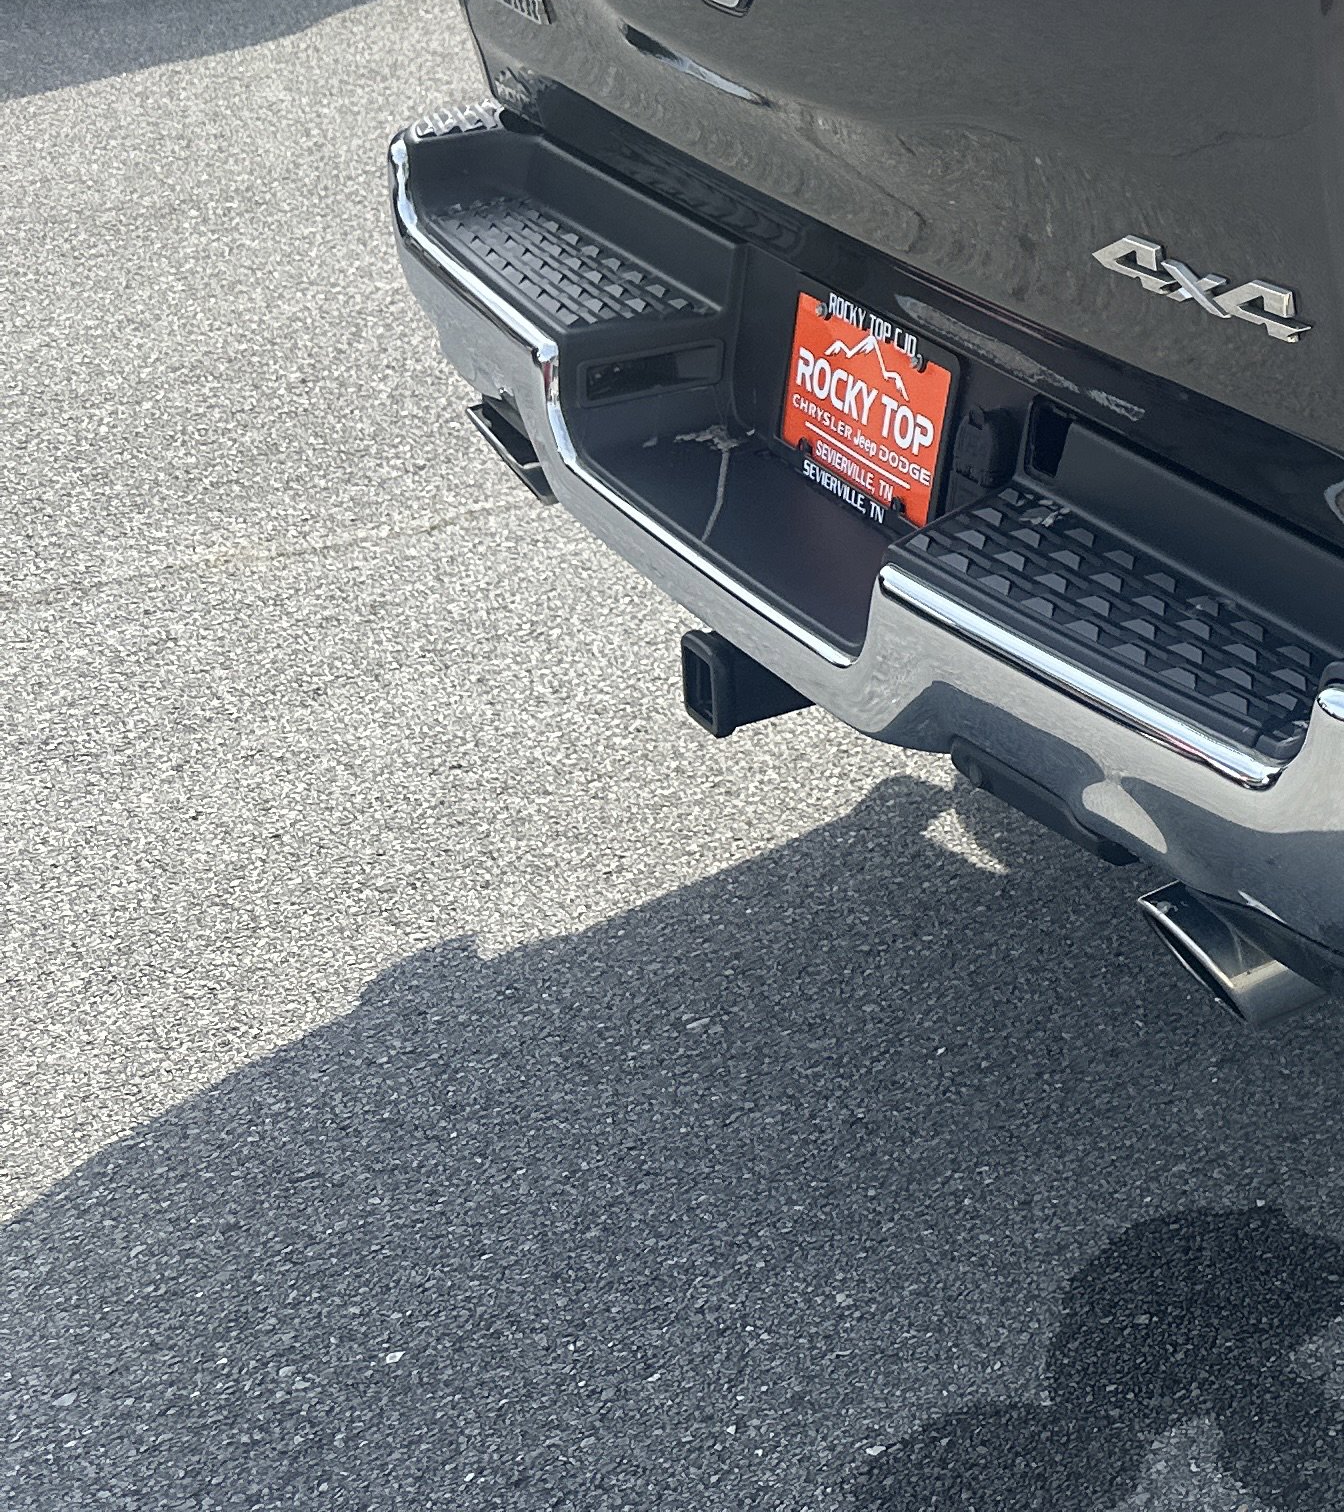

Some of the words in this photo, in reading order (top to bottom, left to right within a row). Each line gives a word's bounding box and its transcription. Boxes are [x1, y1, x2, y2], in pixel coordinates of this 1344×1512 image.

[828, 291, 867, 330] ROCKY
[869, 312, 892, 344] TOP
[795, 346, 879, 426] ROCKY
[881, 394, 935, 457] TOP
[792, 393, 852, 442] CHRYSLER
[853, 432, 877, 458] Jeep
[878, 444, 931, 486] DODGE
[815, 439, 876, 495] SEVIERVILLE,
[879, 479, 894, 503] TN
[802, 459, 867, 515] SEVIERVILLE,
[869, 503, 886, 524] TN
